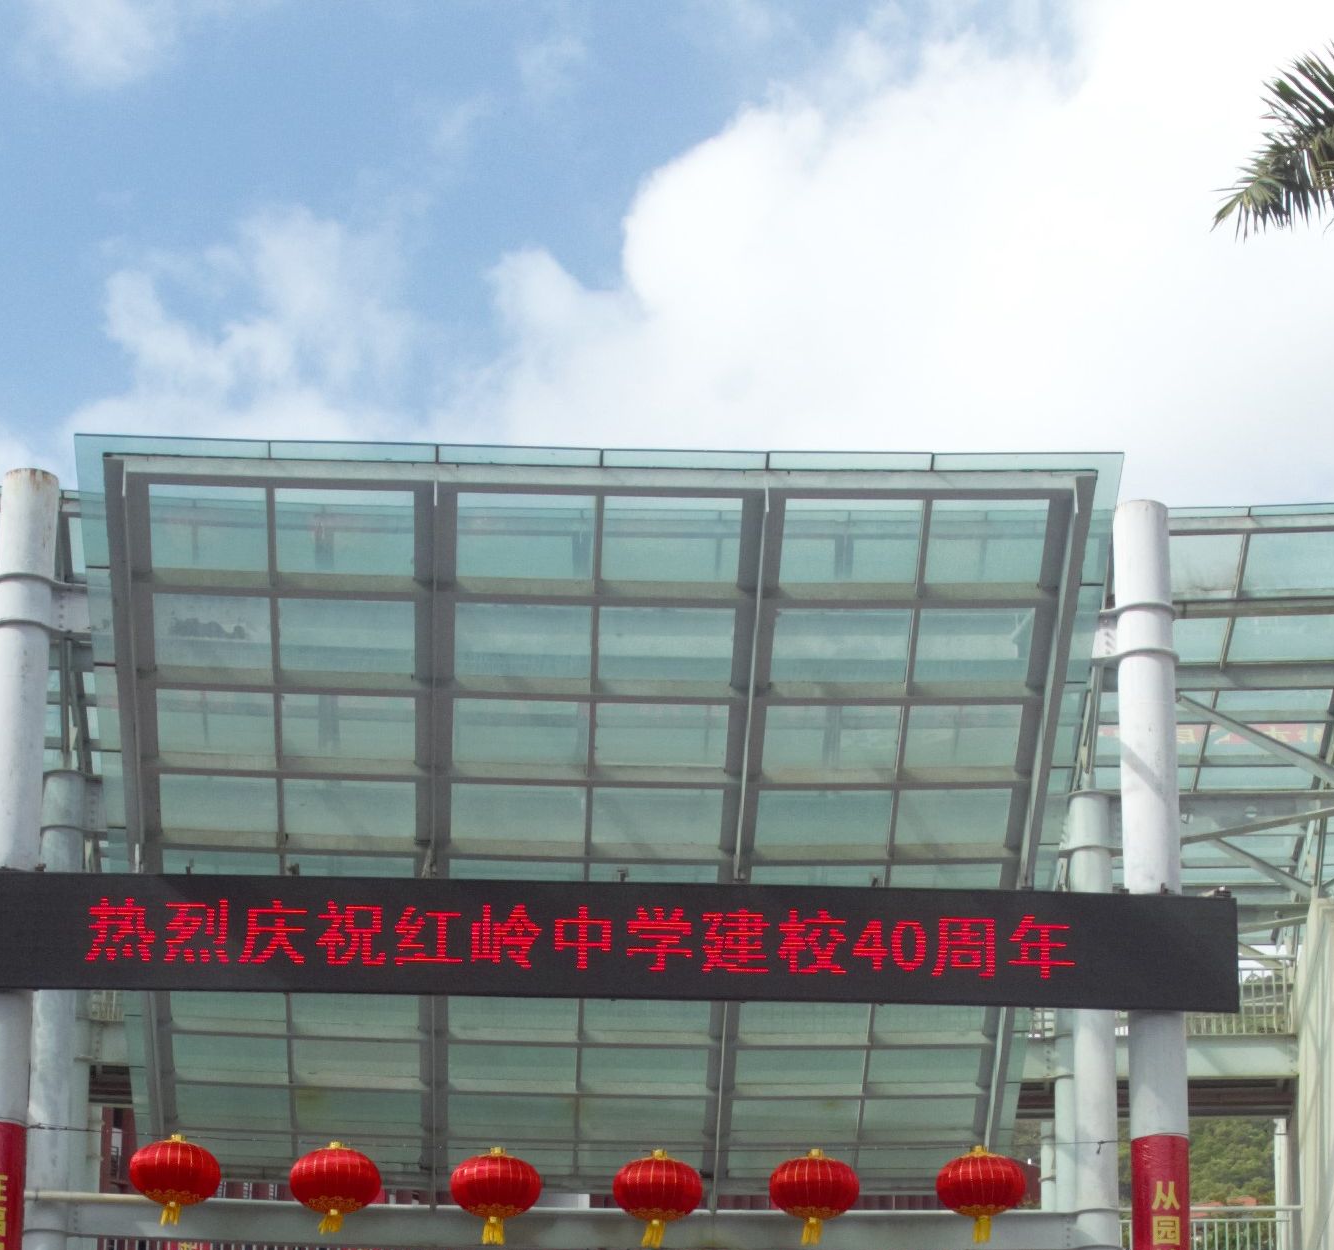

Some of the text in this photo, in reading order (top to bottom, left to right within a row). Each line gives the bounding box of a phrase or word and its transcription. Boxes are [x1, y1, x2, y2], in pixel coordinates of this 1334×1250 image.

[86, 897, 1074, 979] 热烈庆祝红岭中学建校40周年
